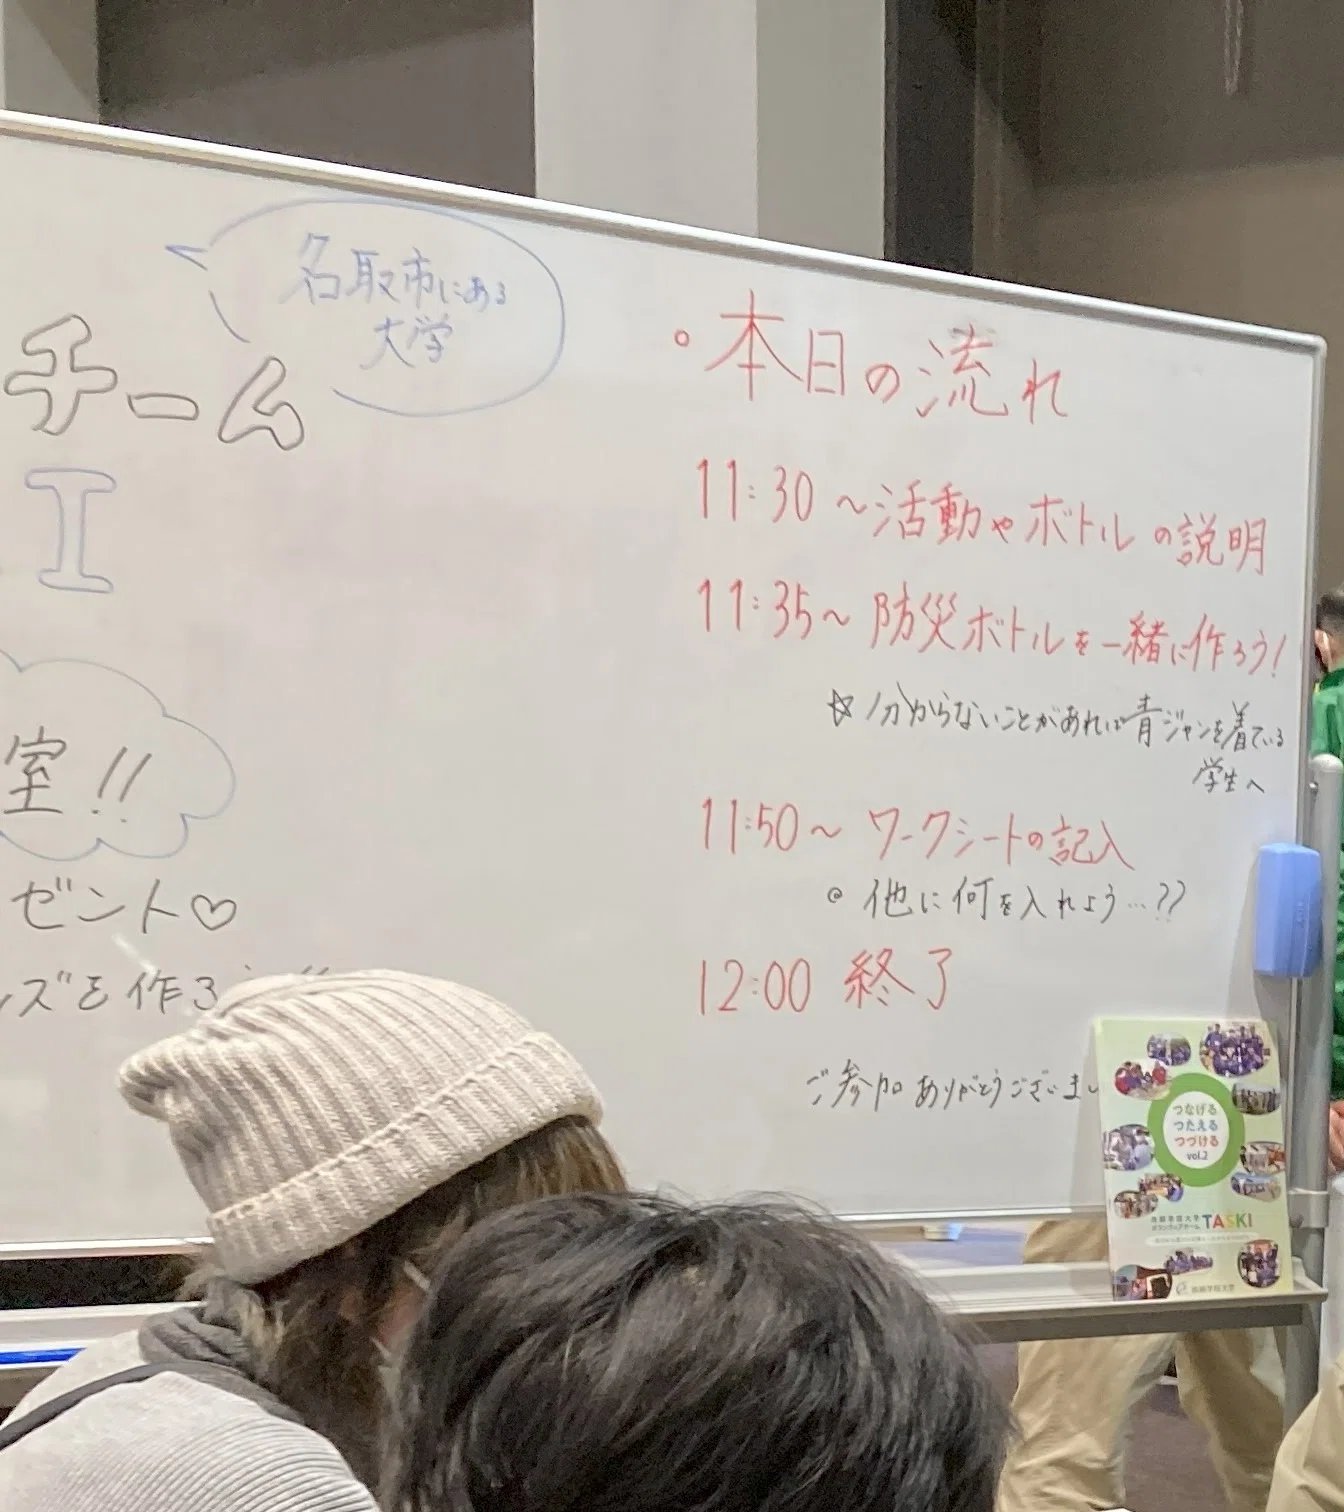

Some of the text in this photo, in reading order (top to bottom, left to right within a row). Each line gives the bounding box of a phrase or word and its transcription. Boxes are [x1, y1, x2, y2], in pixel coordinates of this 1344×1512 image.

[358, 313, 455, 370] 大学
[703, 289, 1069, 424] 本日の流れ
[3, 312, 305, 452] チーム
[696, 457, 814, 523] 11:30
[699, 946, 953, 1015] 12:00 終了
[1172, 1102, 1218, 1116] つなげる
[1173, 1118, 1219, 1133] つたえる
[1174, 1134, 1220, 1148] つづける
[1186, 1150, 1209, 1162] vol.2
[1201, 1212, 1253, 1230] TASKI
